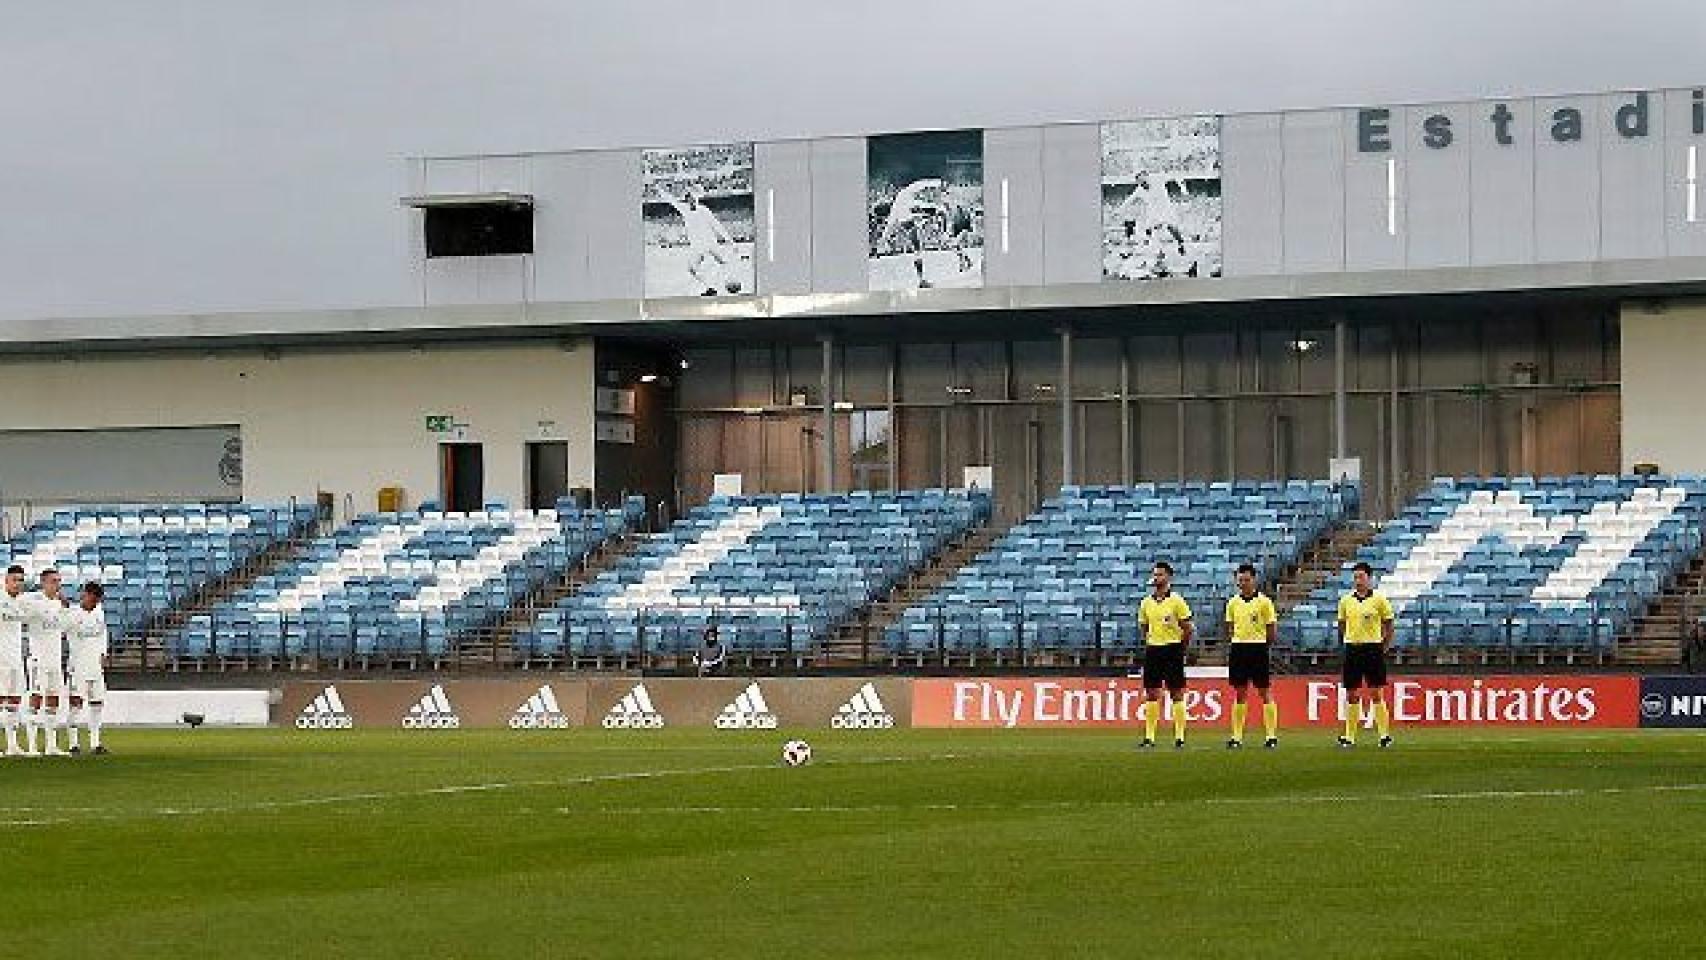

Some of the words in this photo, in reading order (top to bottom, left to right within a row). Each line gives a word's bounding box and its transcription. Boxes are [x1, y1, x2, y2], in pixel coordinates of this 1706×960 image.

[1358, 89, 1704, 152] Estadi
[953, 682, 1024, 728] Fly
[1393, 680, 1596, 721] Emirates
[295, 712, 353, 729] adidas
[402, 712, 460, 729] adidas
[509, 712, 569, 729] adidas
[602, 712, 665, 729] adidas
[714, 712, 778, 729] adidas
[831, 712, 895, 729] adidas
